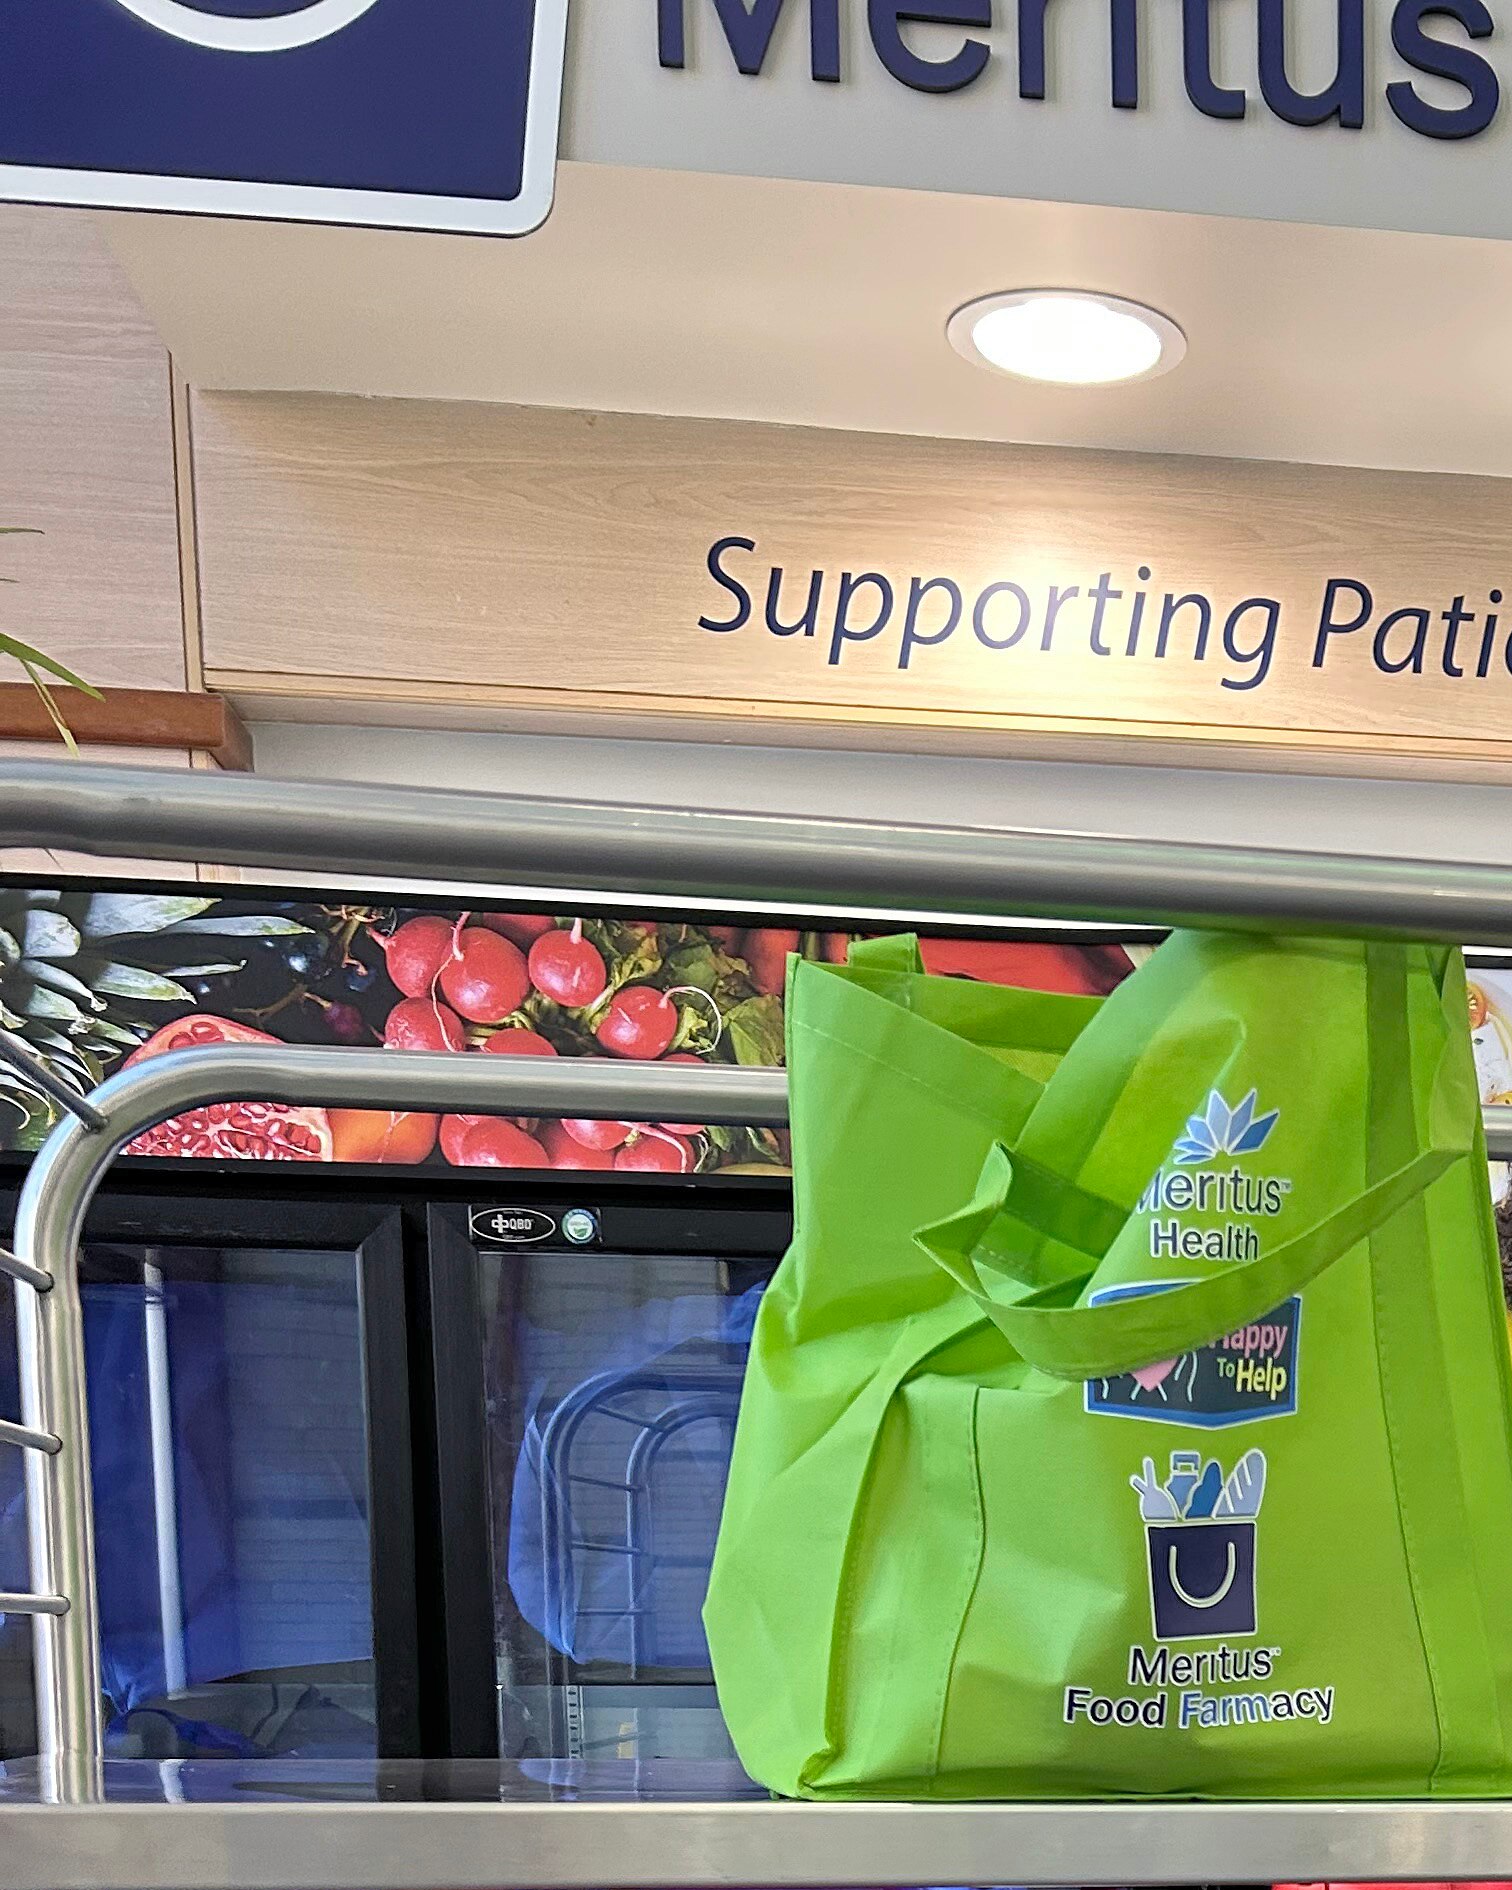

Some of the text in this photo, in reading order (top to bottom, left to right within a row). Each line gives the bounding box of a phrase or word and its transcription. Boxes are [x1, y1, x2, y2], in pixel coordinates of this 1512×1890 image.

[697, 536, 1281, 691] Supporting
[1150, 1220, 1259, 1261] Health
[1217, 1357, 1288, 1400] To Help
[1064, 1686, 1335, 1727] Food Farmacy
